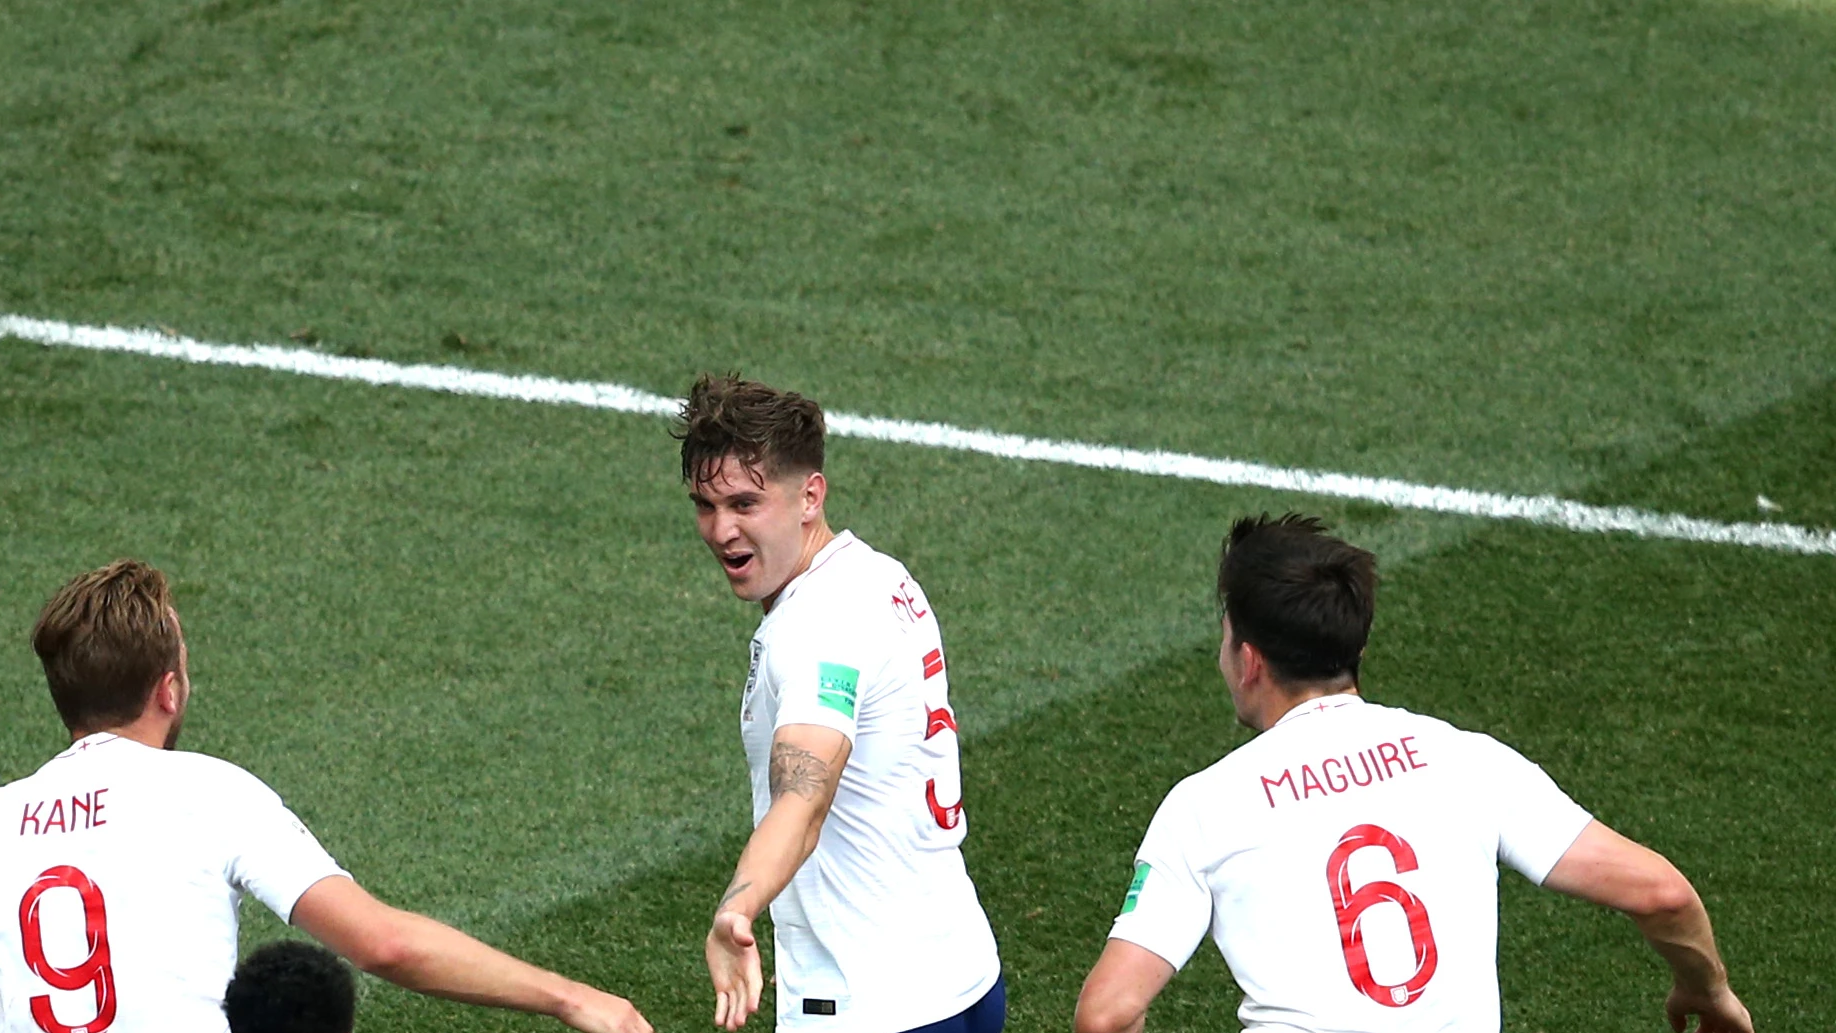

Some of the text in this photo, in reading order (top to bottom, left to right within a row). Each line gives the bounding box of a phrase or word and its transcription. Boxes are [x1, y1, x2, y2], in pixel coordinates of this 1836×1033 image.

[1260, 735, 1428, 808] MAGUIRE
[20, 788, 109, 836] KANE
[1326, 823, 1439, 1008] 6
